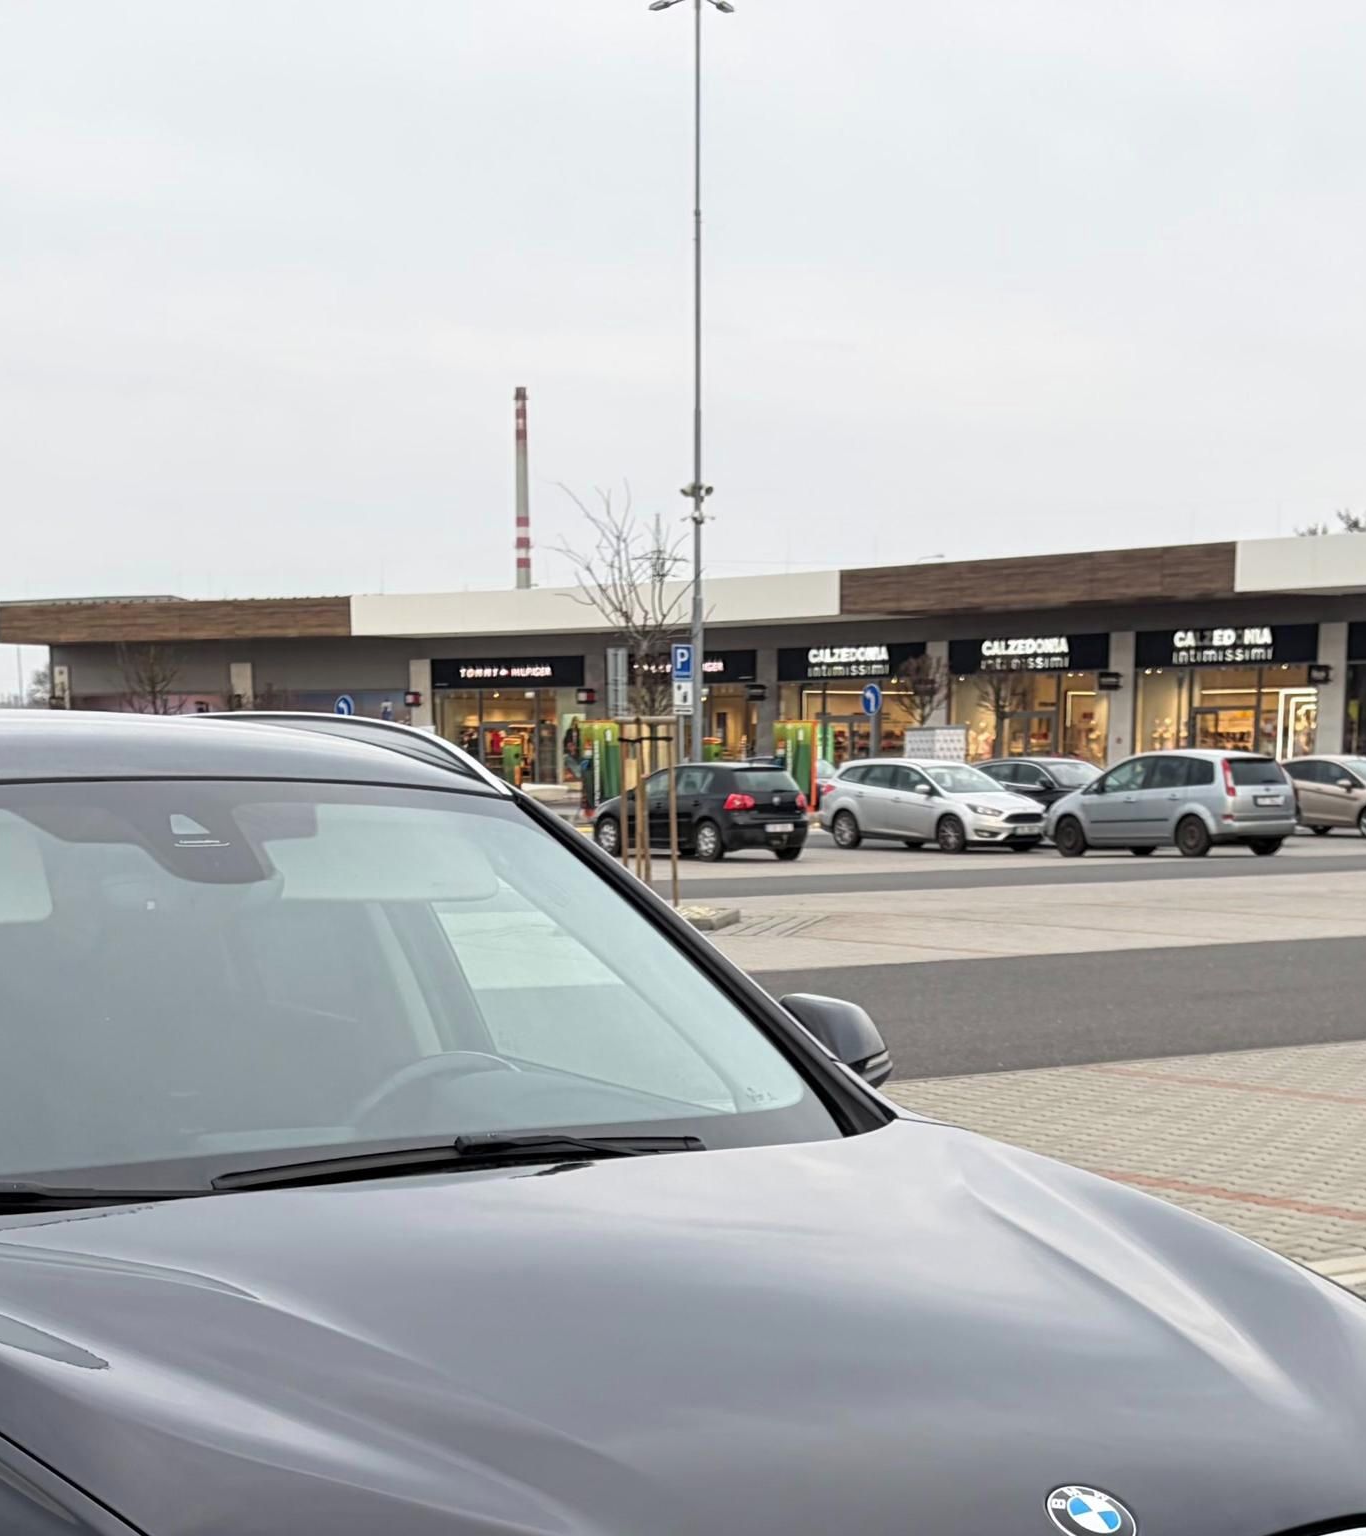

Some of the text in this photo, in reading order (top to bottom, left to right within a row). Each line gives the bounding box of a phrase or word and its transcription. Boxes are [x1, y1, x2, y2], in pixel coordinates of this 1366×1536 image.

[1173, 626, 1273, 647] CALZEDONIA
[808, 646, 889, 664] CALZEDONIA
[981, 636, 1069, 656] CALZEDONIA
[676, 648, 689, 669] P
[1172, 647, 1274, 665] intimissimi
[459, 666, 552, 678] TOMMY HILFIGER
[807, 664, 890, 678] intimissimi
